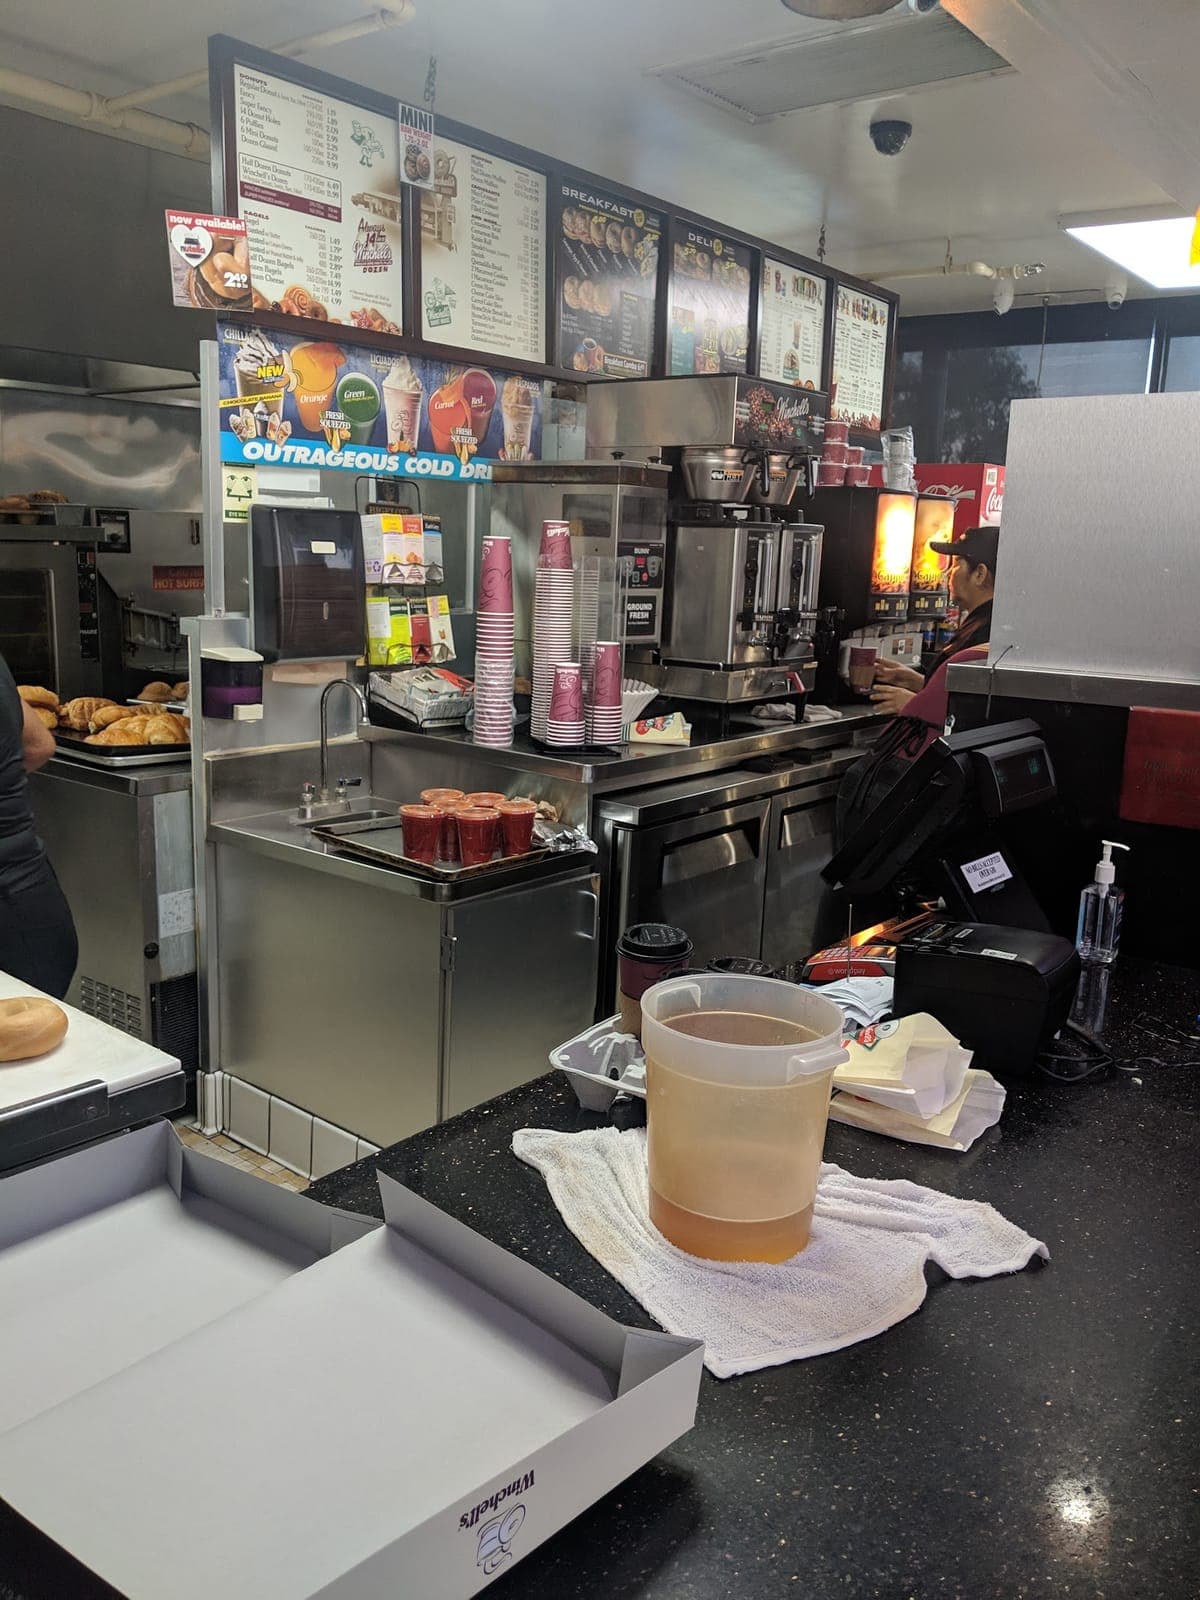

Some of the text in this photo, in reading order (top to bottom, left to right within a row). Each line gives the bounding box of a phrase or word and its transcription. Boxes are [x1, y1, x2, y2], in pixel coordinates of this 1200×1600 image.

[401, 106, 433, 134] MINI
[255, 159, 271, 172] Dozen
[562, 186, 634, 218] BREAKFAST
[244, 210, 269, 220] BAGELS
[169, 215, 245, 231] now available!
[358, 218, 386, 232] Always
[366, 232, 376, 247] 14
[688, 232, 713, 247] DELI
[353, 239, 393, 261] Winchell's
[258, 255, 276, 266] Dozen
[277, 259, 294, 270] Bagels
[257, 365, 284, 379] NEW
[222, 393, 283, 406] CHOCOLATE BANANA
[300, 394, 328, 404] Orange
[344, 390, 365, 399] Green
[434, 401, 455, 410] Carrot
[777, 397, 810, 421] Winchell's
[326, 410, 344, 420] FRESH
[320, 418, 351, 430] SQUEEZED
[456, 427, 473, 436] FRESH
[243, 441, 399, 472] OUTRAGEOUS
[405, 458, 455, 476] COLD
[634, 547, 650, 555] BUNN
[154, 578, 173, 589] HOT
[627, 603, 653, 611] GROUND
[629, 611, 649, 619] FRESH
[833, 966, 866, 978] wordpay
[459, 1469, 535, 1529] Winchell's
